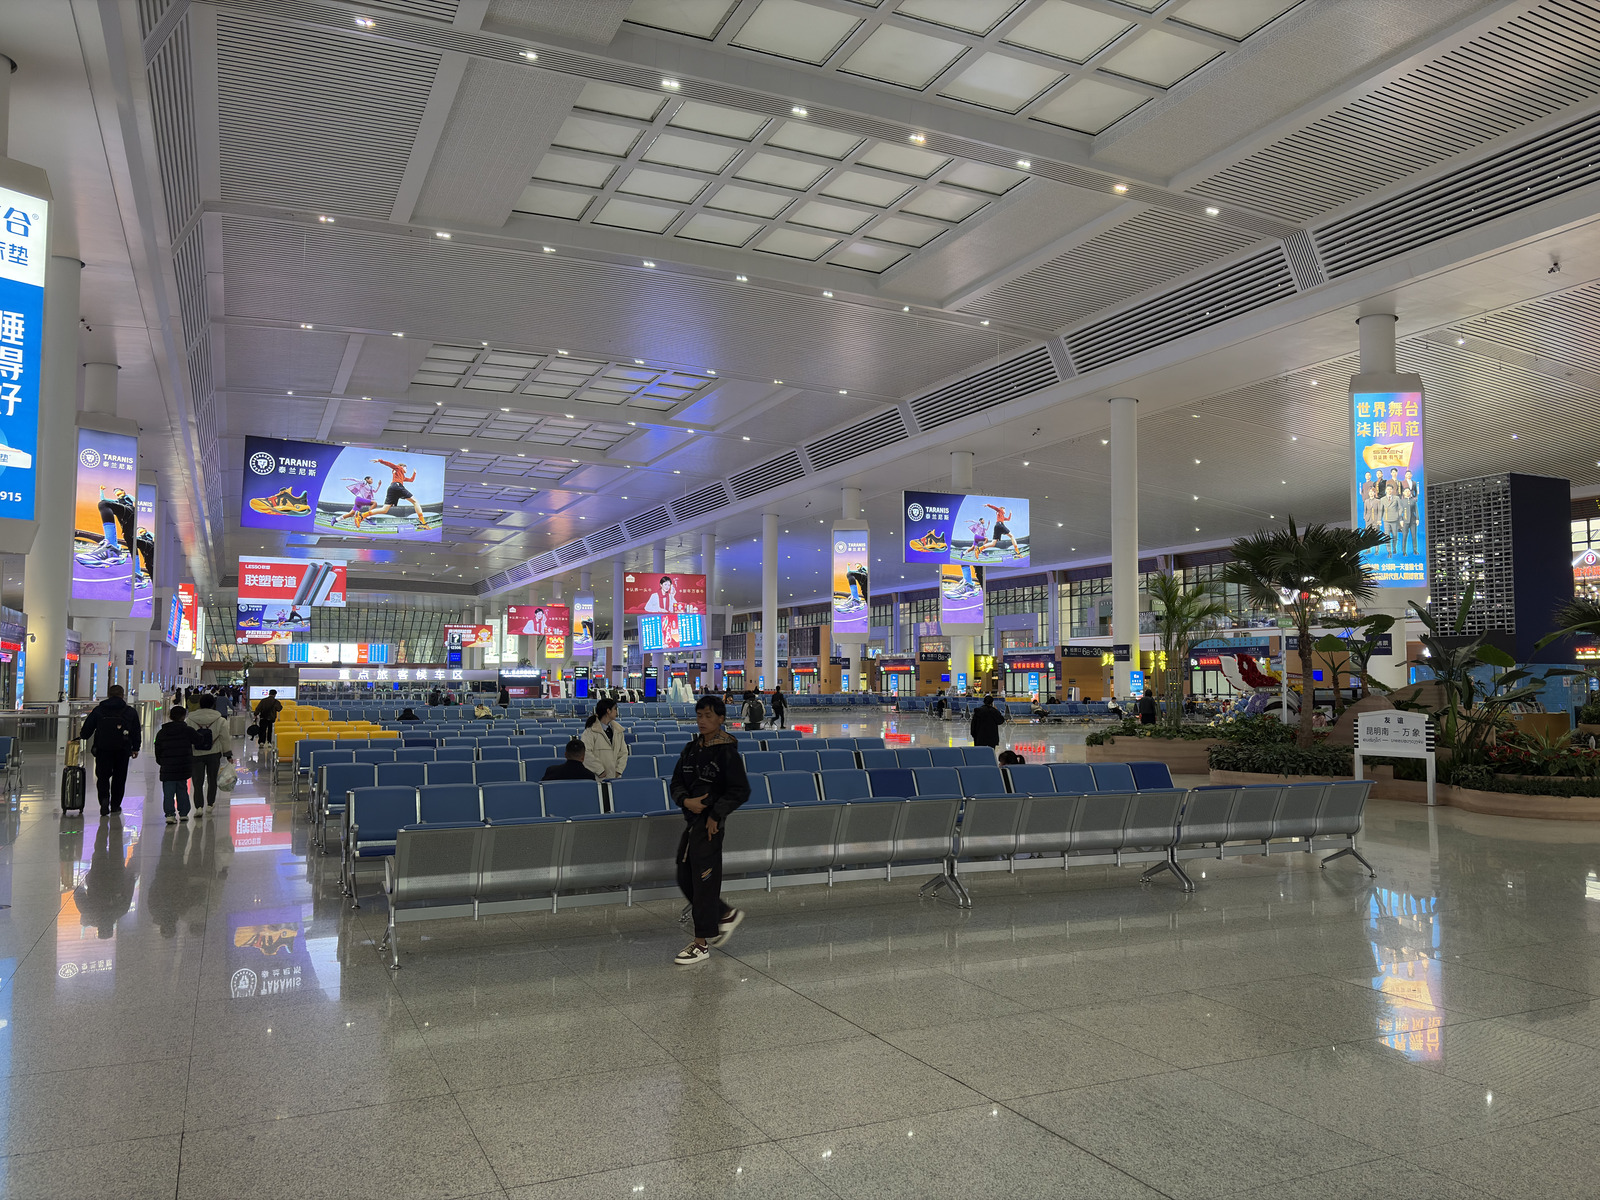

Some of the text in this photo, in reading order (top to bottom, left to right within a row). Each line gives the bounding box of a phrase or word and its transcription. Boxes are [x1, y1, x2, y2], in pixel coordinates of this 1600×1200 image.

[0, 206, 32, 237] 合
[1356, 400, 1419, 418] 世界舞台
[1356, 420, 1420, 438] 柒牌风范
[102, 453, 134, 464] TARANIS
[278, 457, 317, 468] TARANIS
[278, 466, 317, 477] 泰兰尼斯
[925, 506, 950, 514] TARANIS
[244, 574, 298, 588] 联塑管道
[338, 669, 464, 680] 重点旅客候车区
